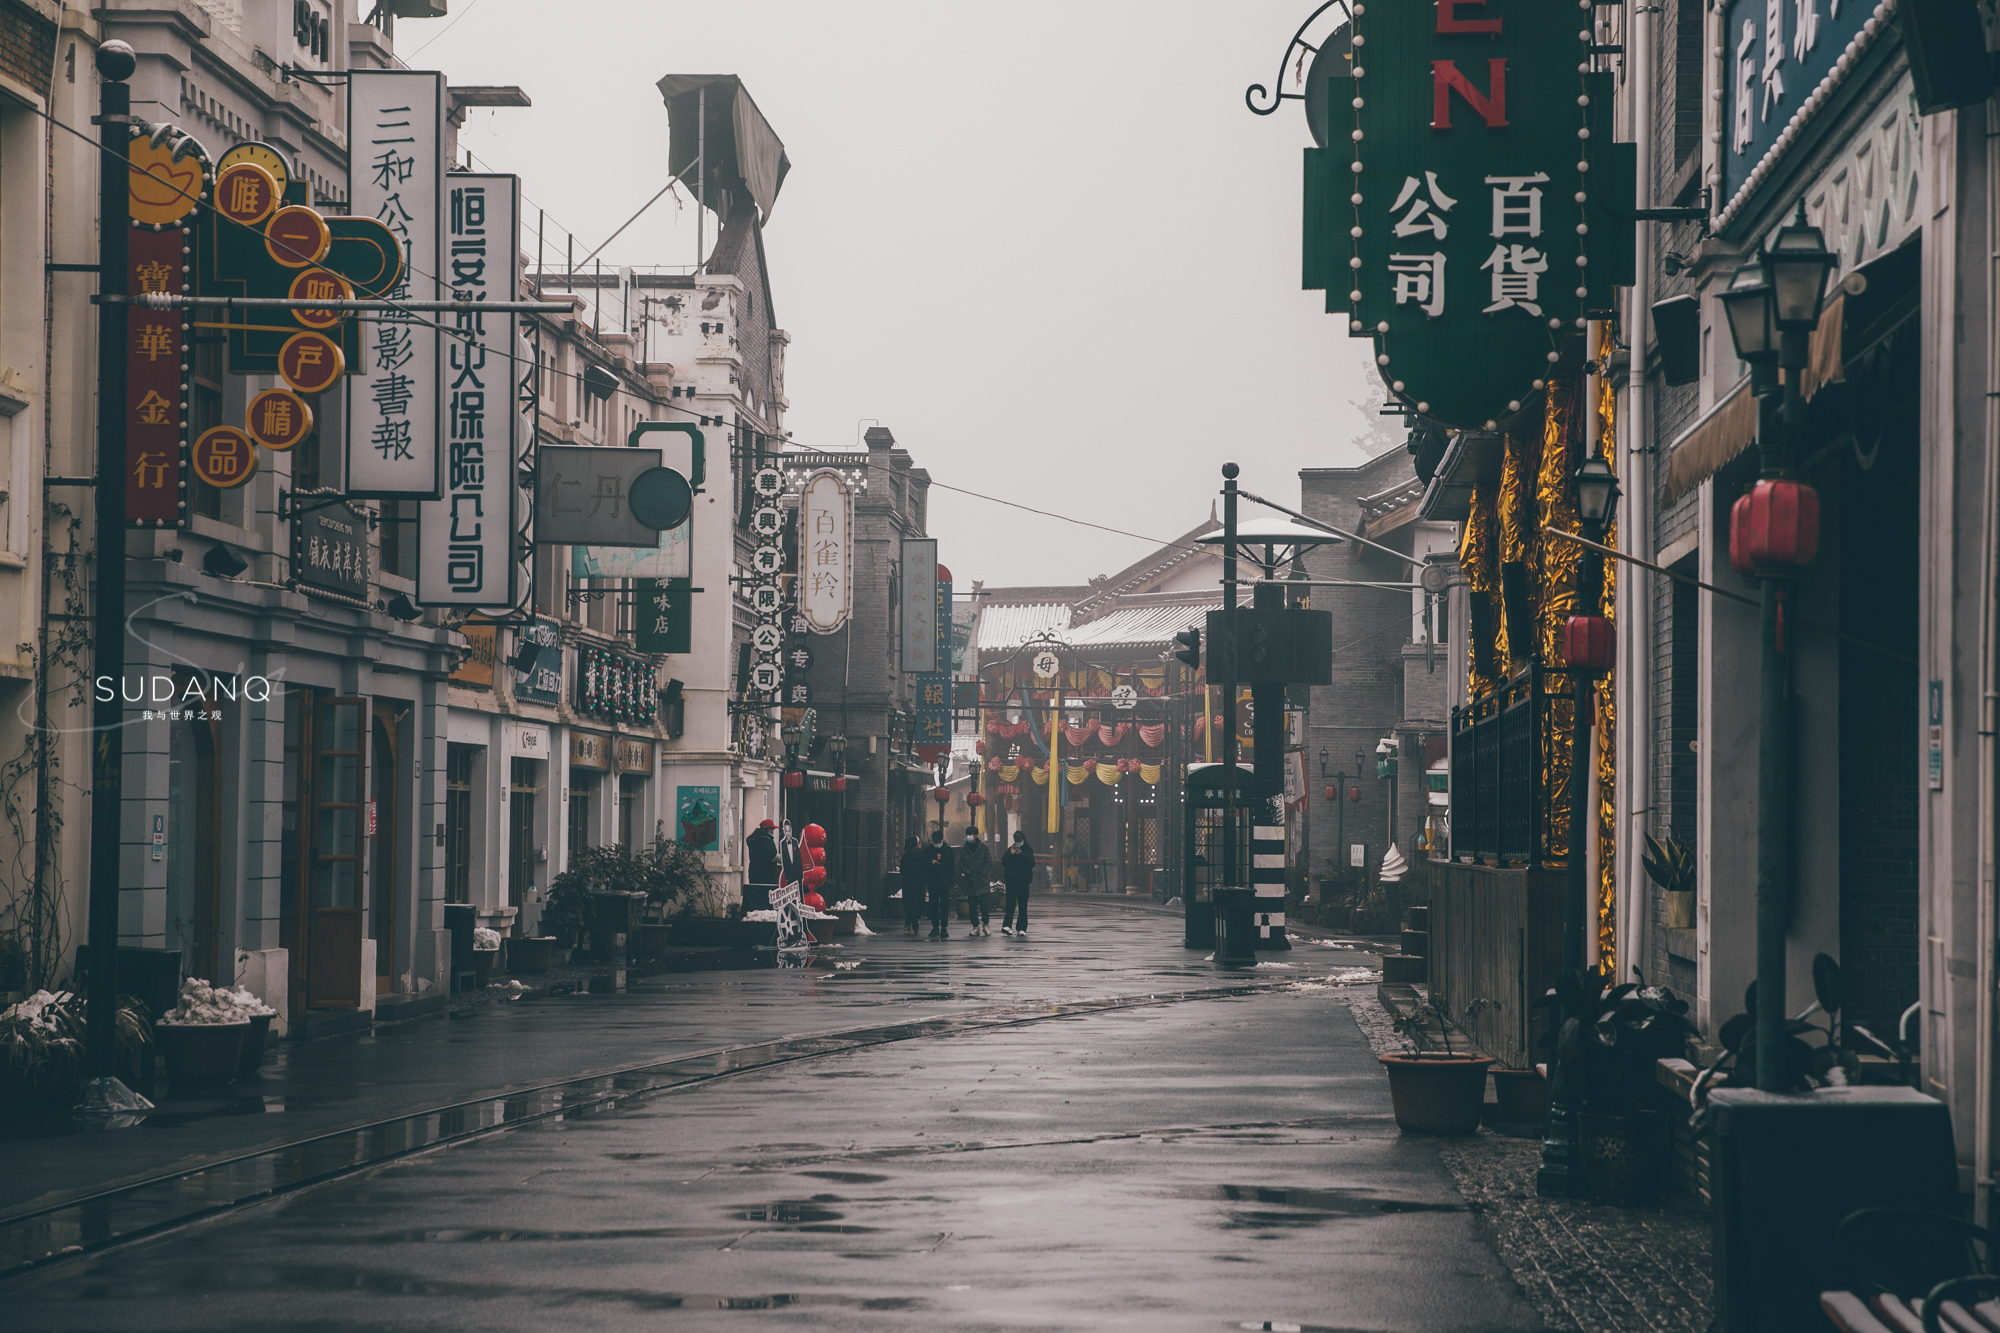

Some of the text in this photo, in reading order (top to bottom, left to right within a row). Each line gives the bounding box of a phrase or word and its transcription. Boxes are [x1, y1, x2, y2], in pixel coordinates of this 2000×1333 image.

[1388, 170, 1458, 319] 公司
[1480, 171, 1550, 318] 百貨
[547, 472, 627, 519] 仁丹
[810, 508, 839, 599] 百雀羚
[757, 473, 779, 687] 華興有限公司
